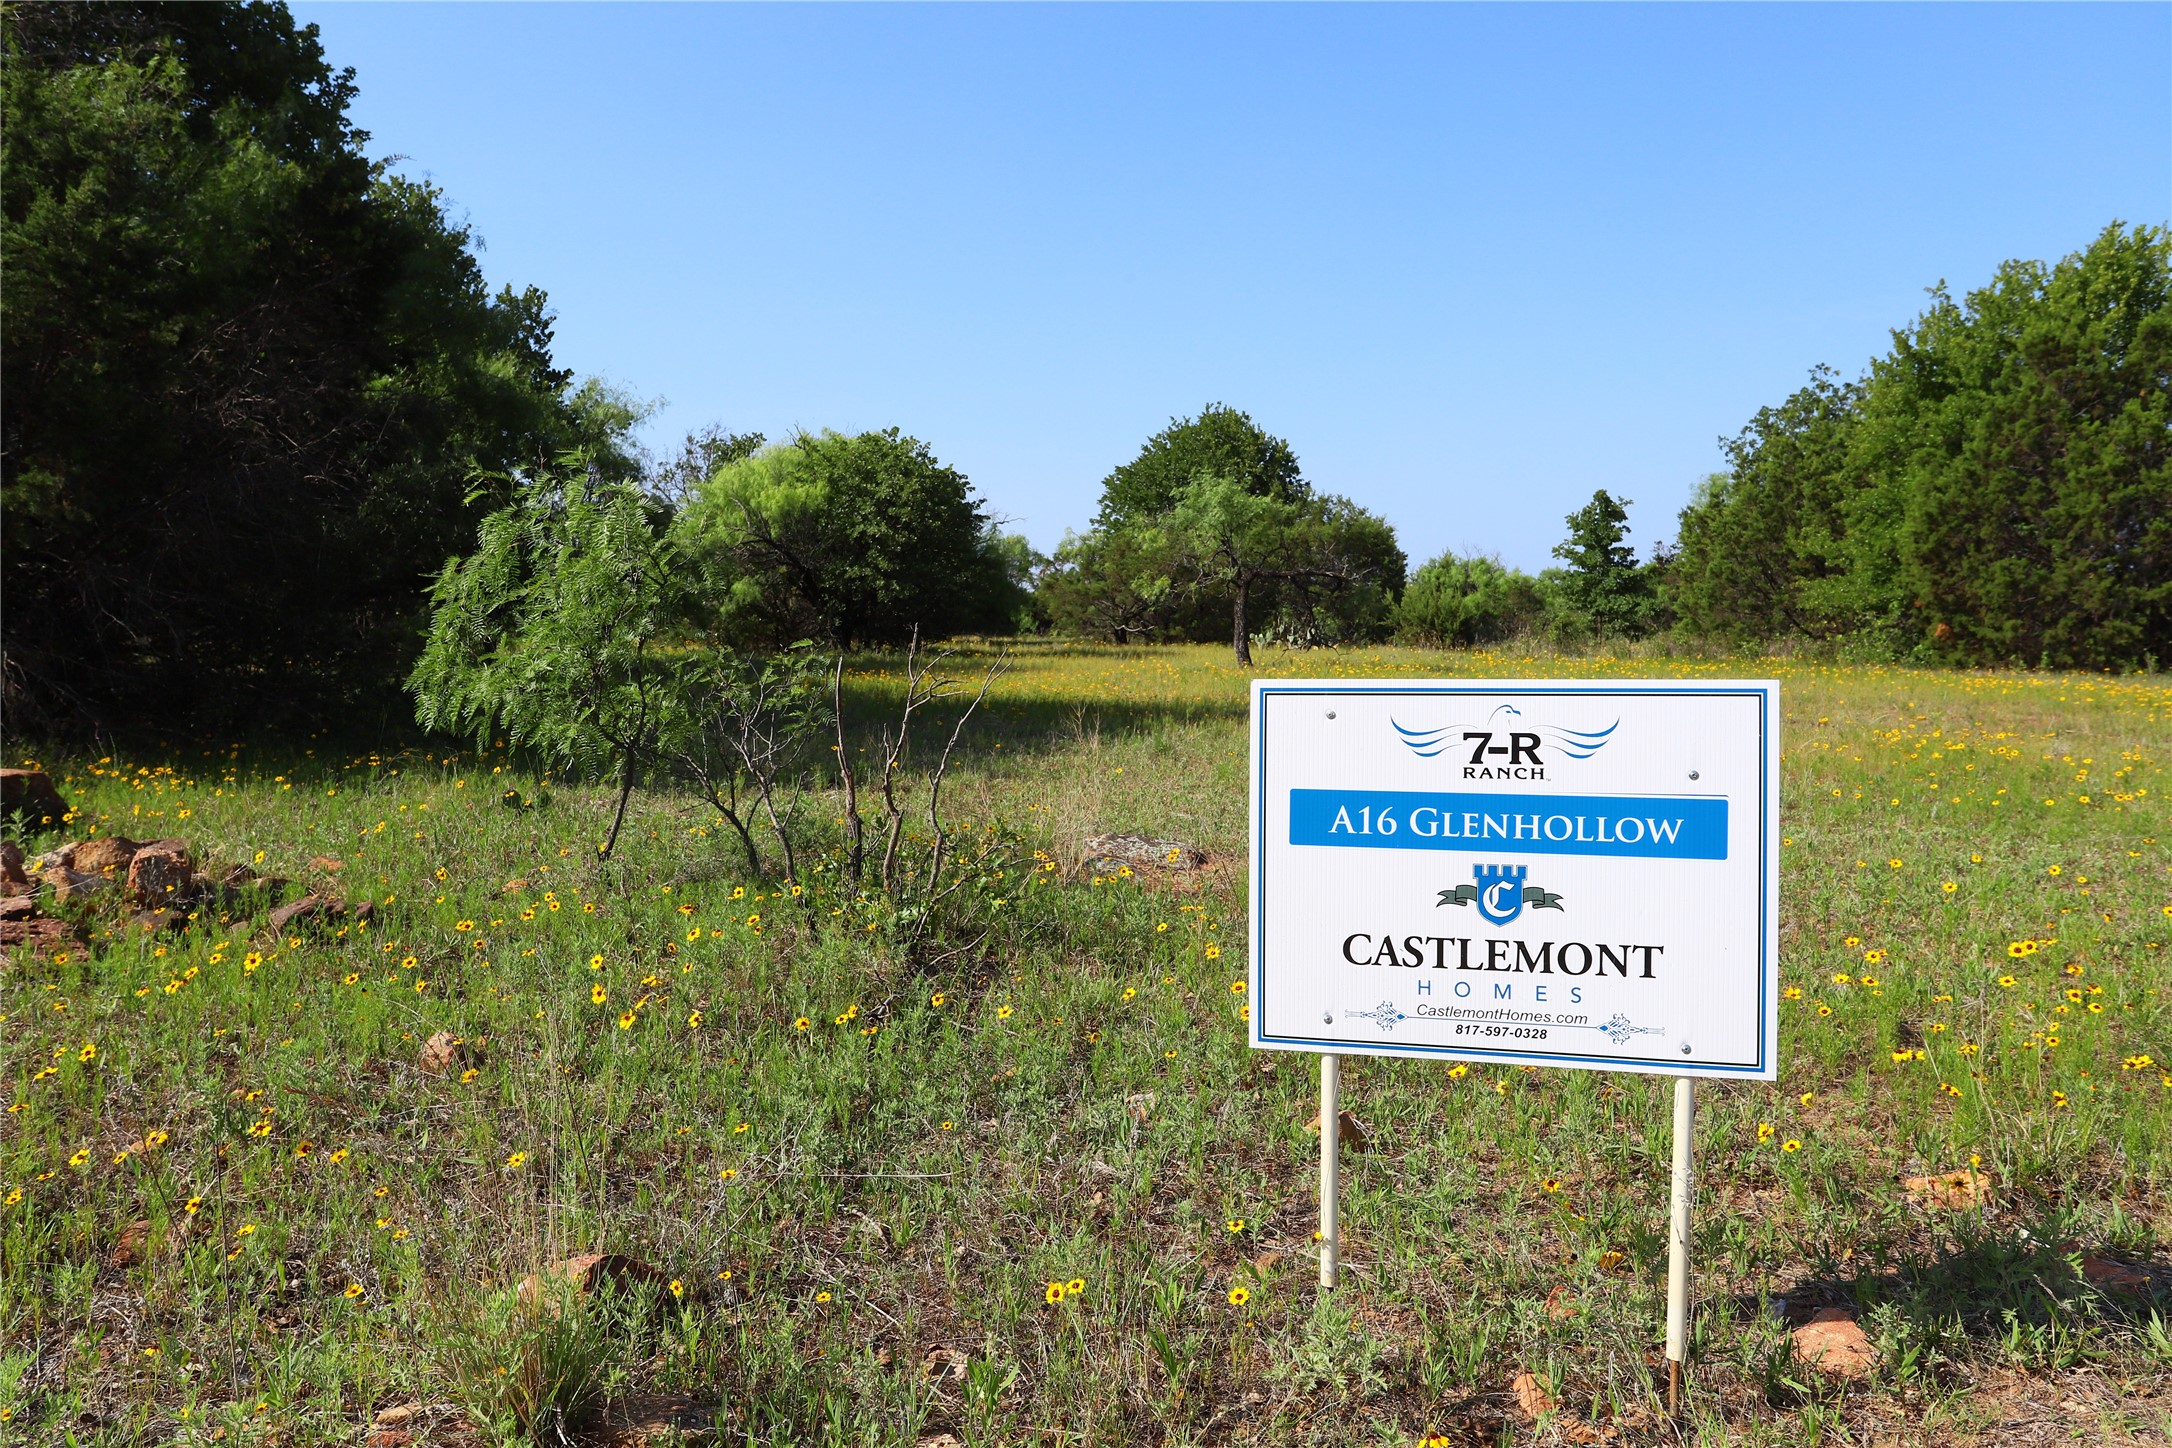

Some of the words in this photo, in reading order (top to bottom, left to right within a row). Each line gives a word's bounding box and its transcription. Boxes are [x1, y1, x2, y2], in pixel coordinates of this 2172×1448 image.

[1463, 732, 1544, 765] 7-R
[1463, 767, 1545, 780] RANCH
[1328, 804, 1397, 836] A16
[1409, 806, 1684, 845] GLENHOLLOW
[1482, 880, 1517, 918] C
[1342, 932, 1665, 979] CASTLEMONT
[1417, 979, 1583, 1004] HOMES
[1416, 1003, 1589, 1025] CastlemontHomes.com
[1455, 1024, 1548, 1041] 817-597-0328
